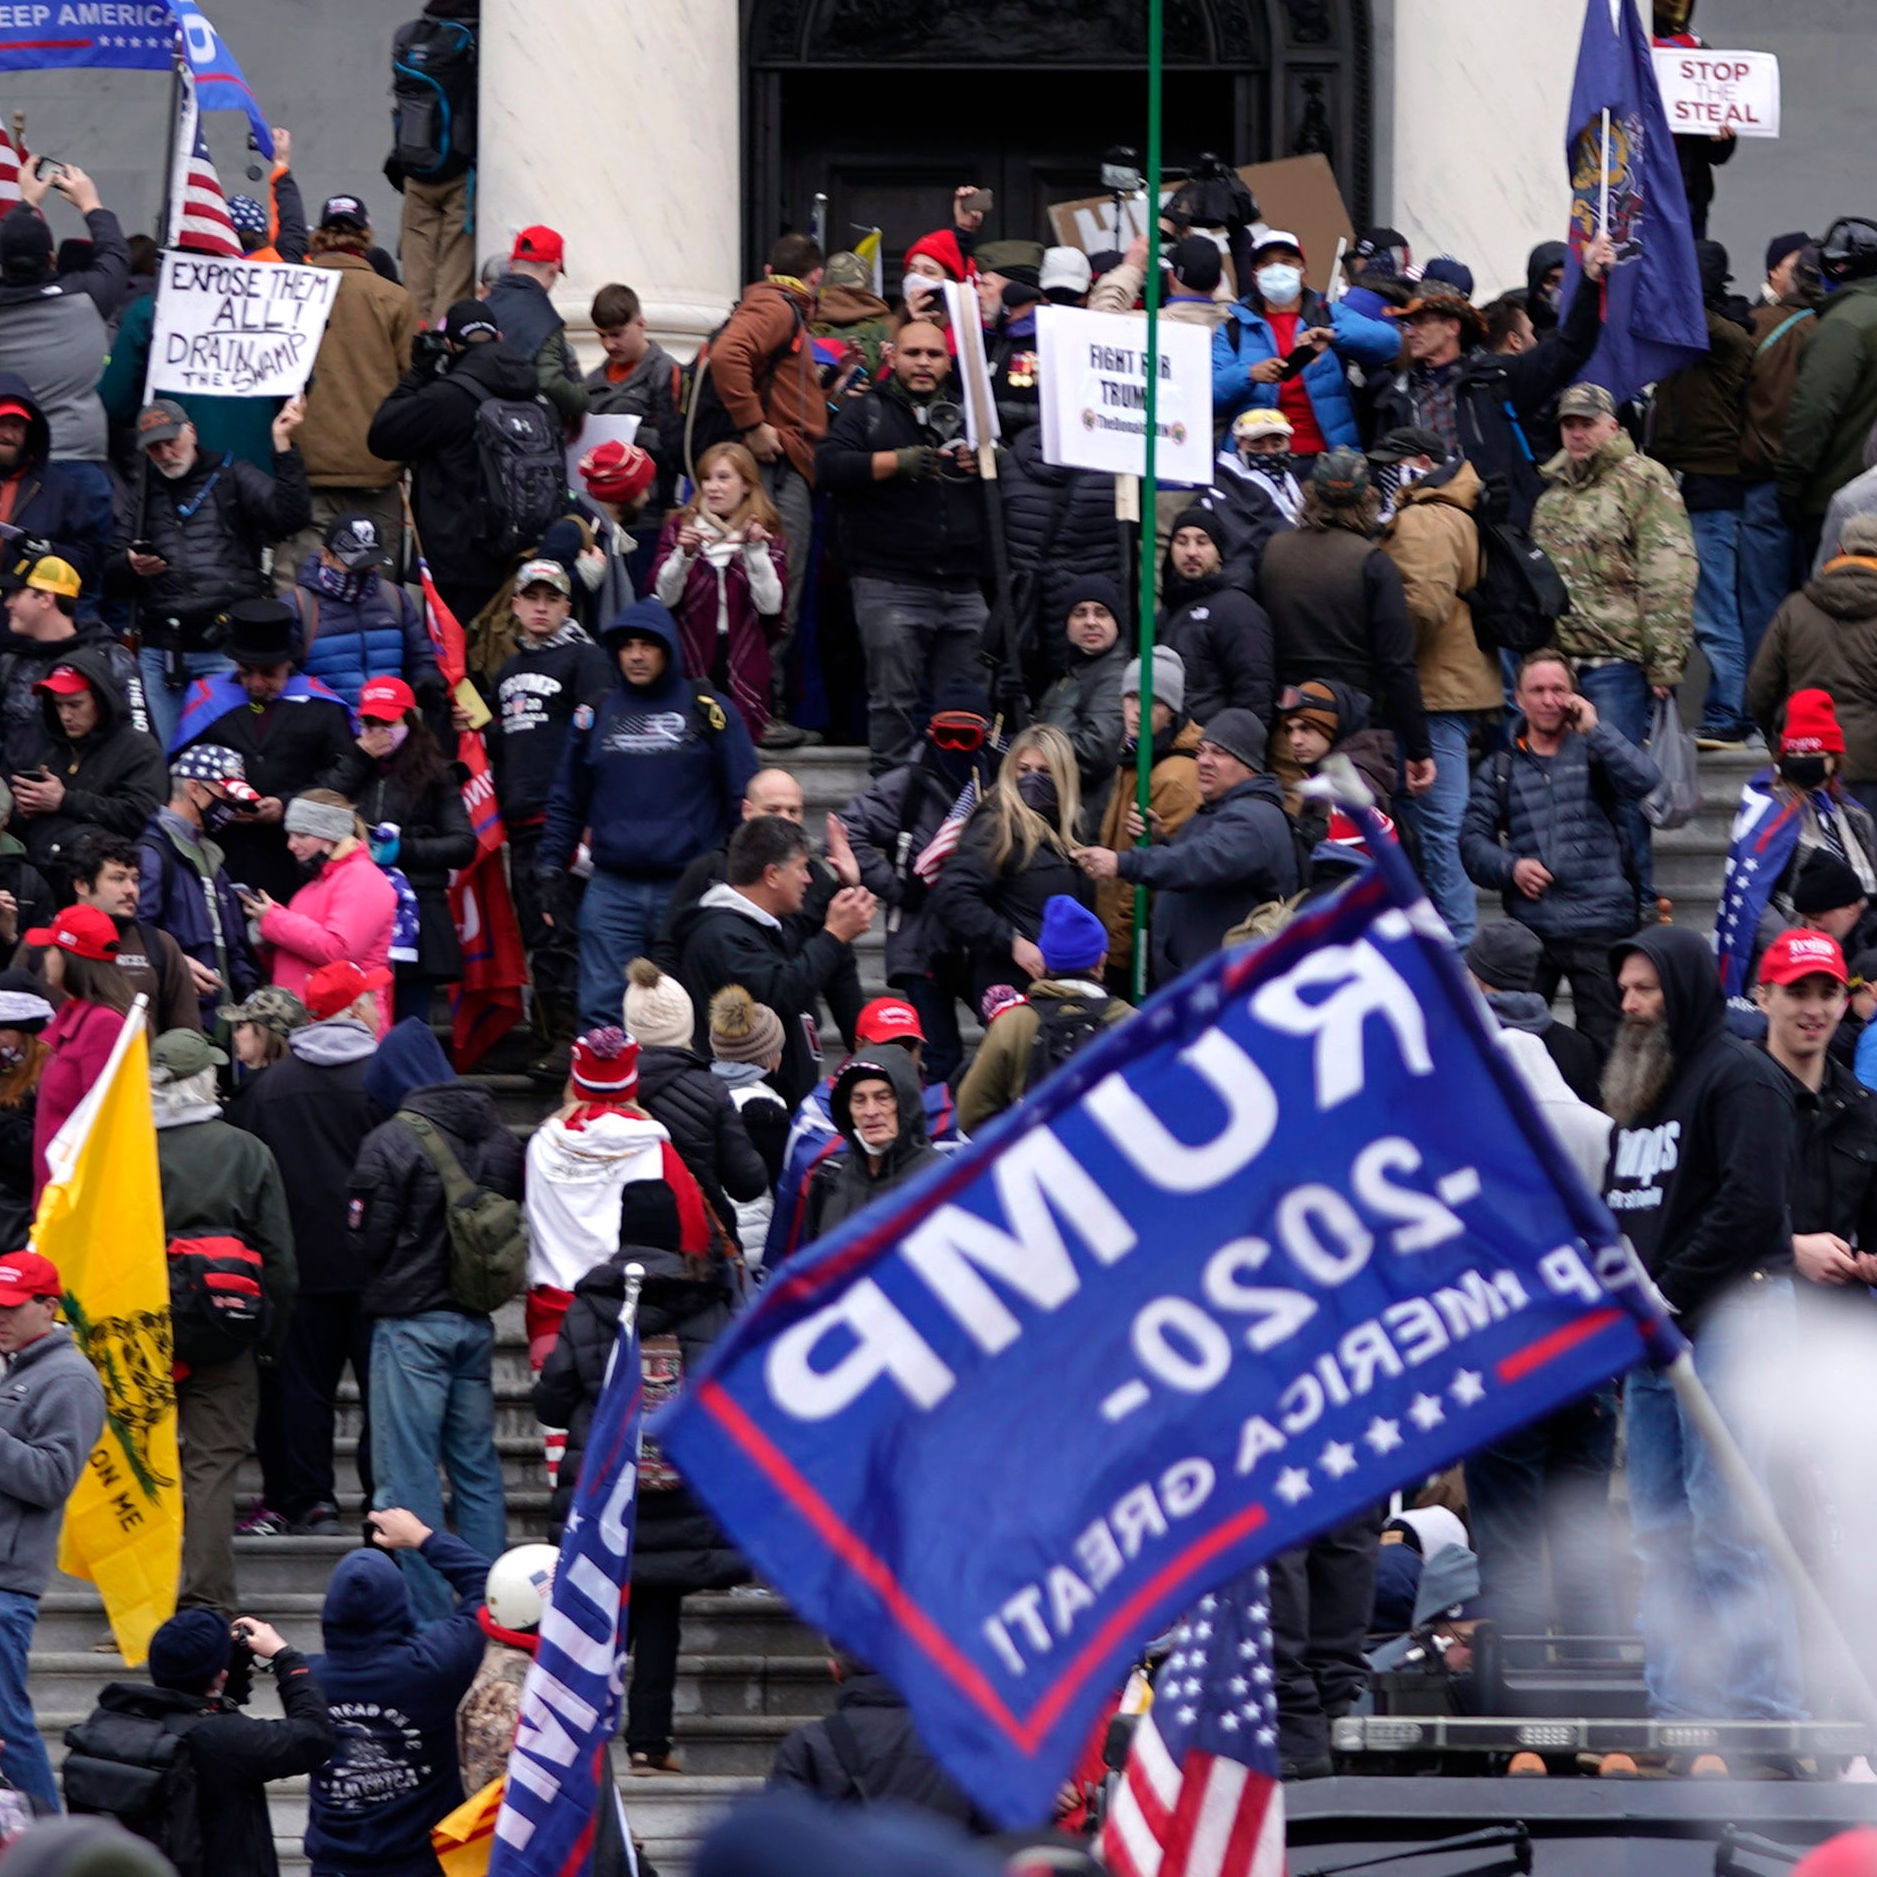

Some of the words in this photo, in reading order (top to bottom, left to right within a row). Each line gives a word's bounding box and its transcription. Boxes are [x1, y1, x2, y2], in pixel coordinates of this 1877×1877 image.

[1679, 60, 1750, 82] STOP
[1694, 82, 1738, 102] THE
[1674, 101, 1761, 124] STEAL
[171, 261, 263, 299] EXPOSE
[269, 268, 330, 305] THEM
[166, 331, 256, 374] DRAIN
[180, 372, 224, 387] THE
[230, 331, 307, 394] SWAMP
[1089, 341, 1135, 375] FIGHT
[1139, 352, 1172, 381] FR
[1099, 378, 1148, 412] TRUM
[89, 1448, 122, 1488] ON
[109, 1491, 145, 1534] ME
